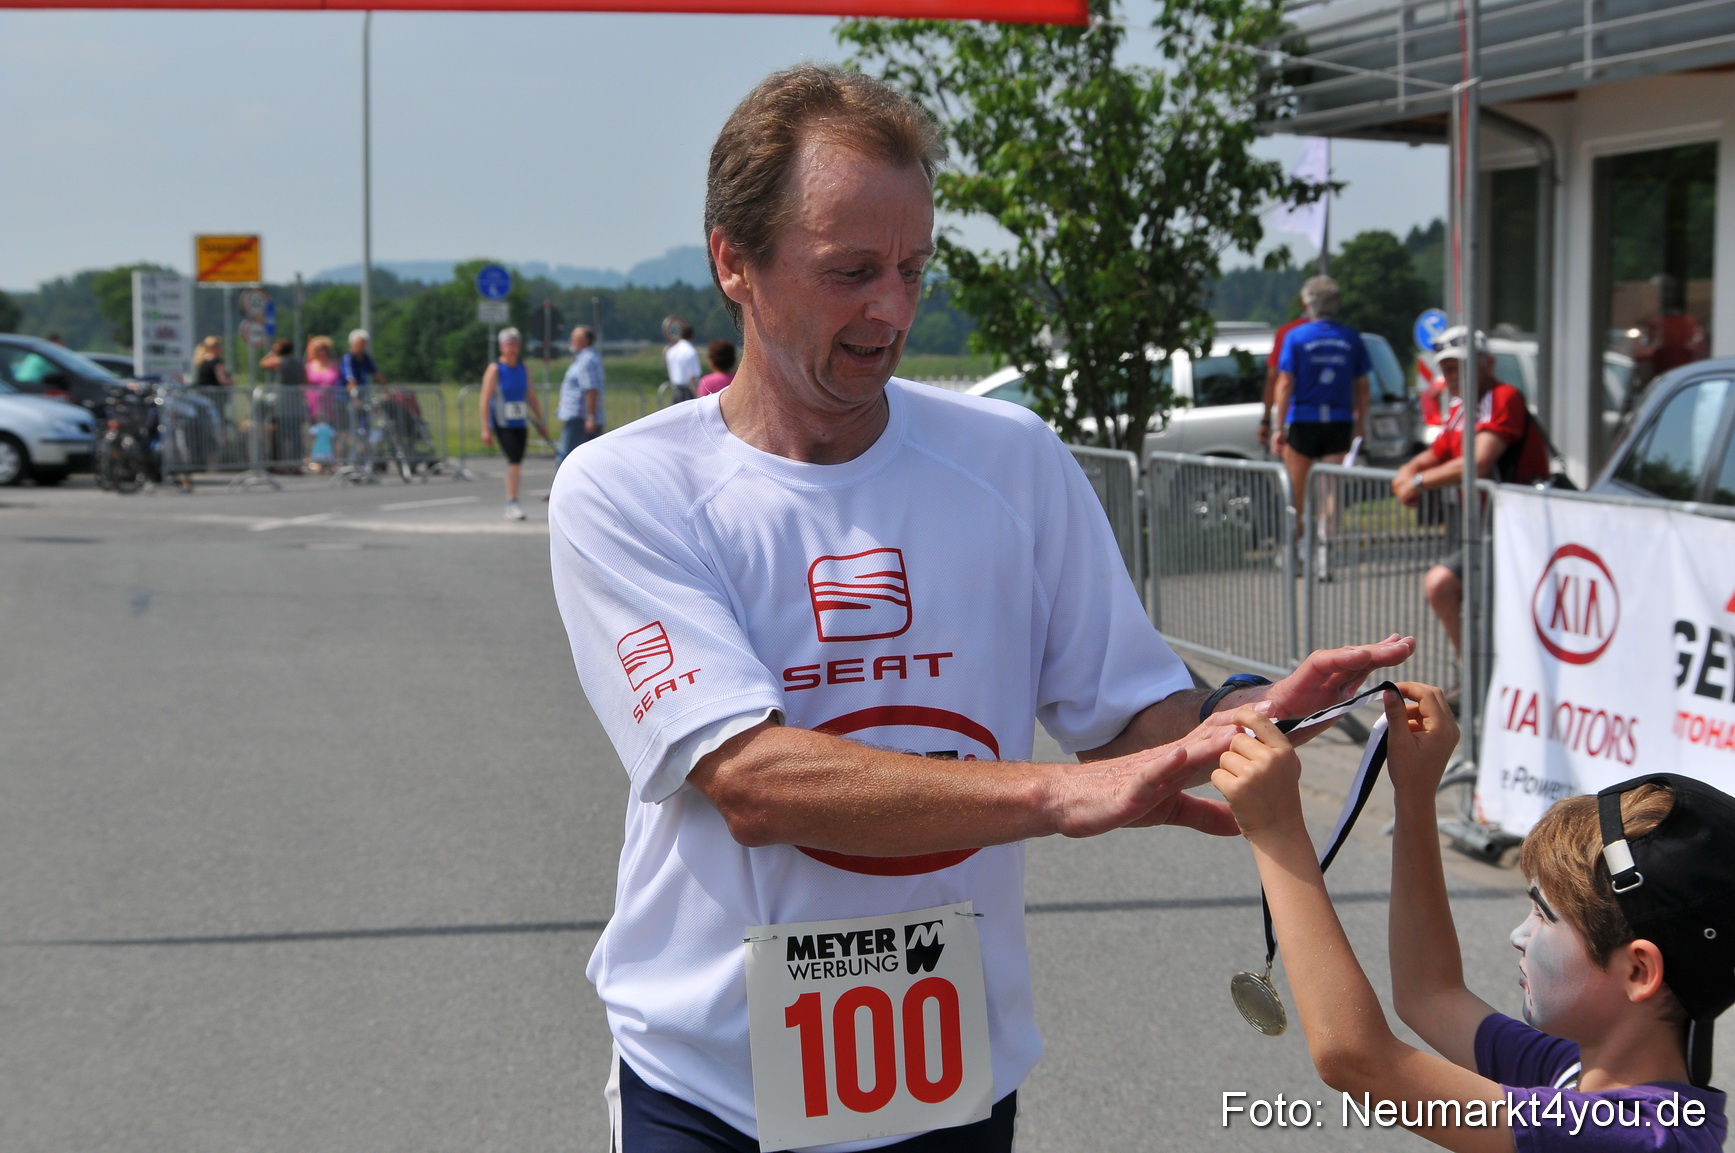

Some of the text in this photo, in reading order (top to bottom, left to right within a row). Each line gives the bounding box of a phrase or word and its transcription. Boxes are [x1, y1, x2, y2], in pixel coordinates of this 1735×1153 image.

[1549, 573, 1603, 639] KIA
[632, 667, 702, 725] SEAT
[782, 651, 953, 692] SEAT
[1501, 686, 1539, 736] IA
[786, 927, 898, 962] MEYER
[787, 954, 899, 981] WERBUNG
[784, 976, 963, 1118] 100
